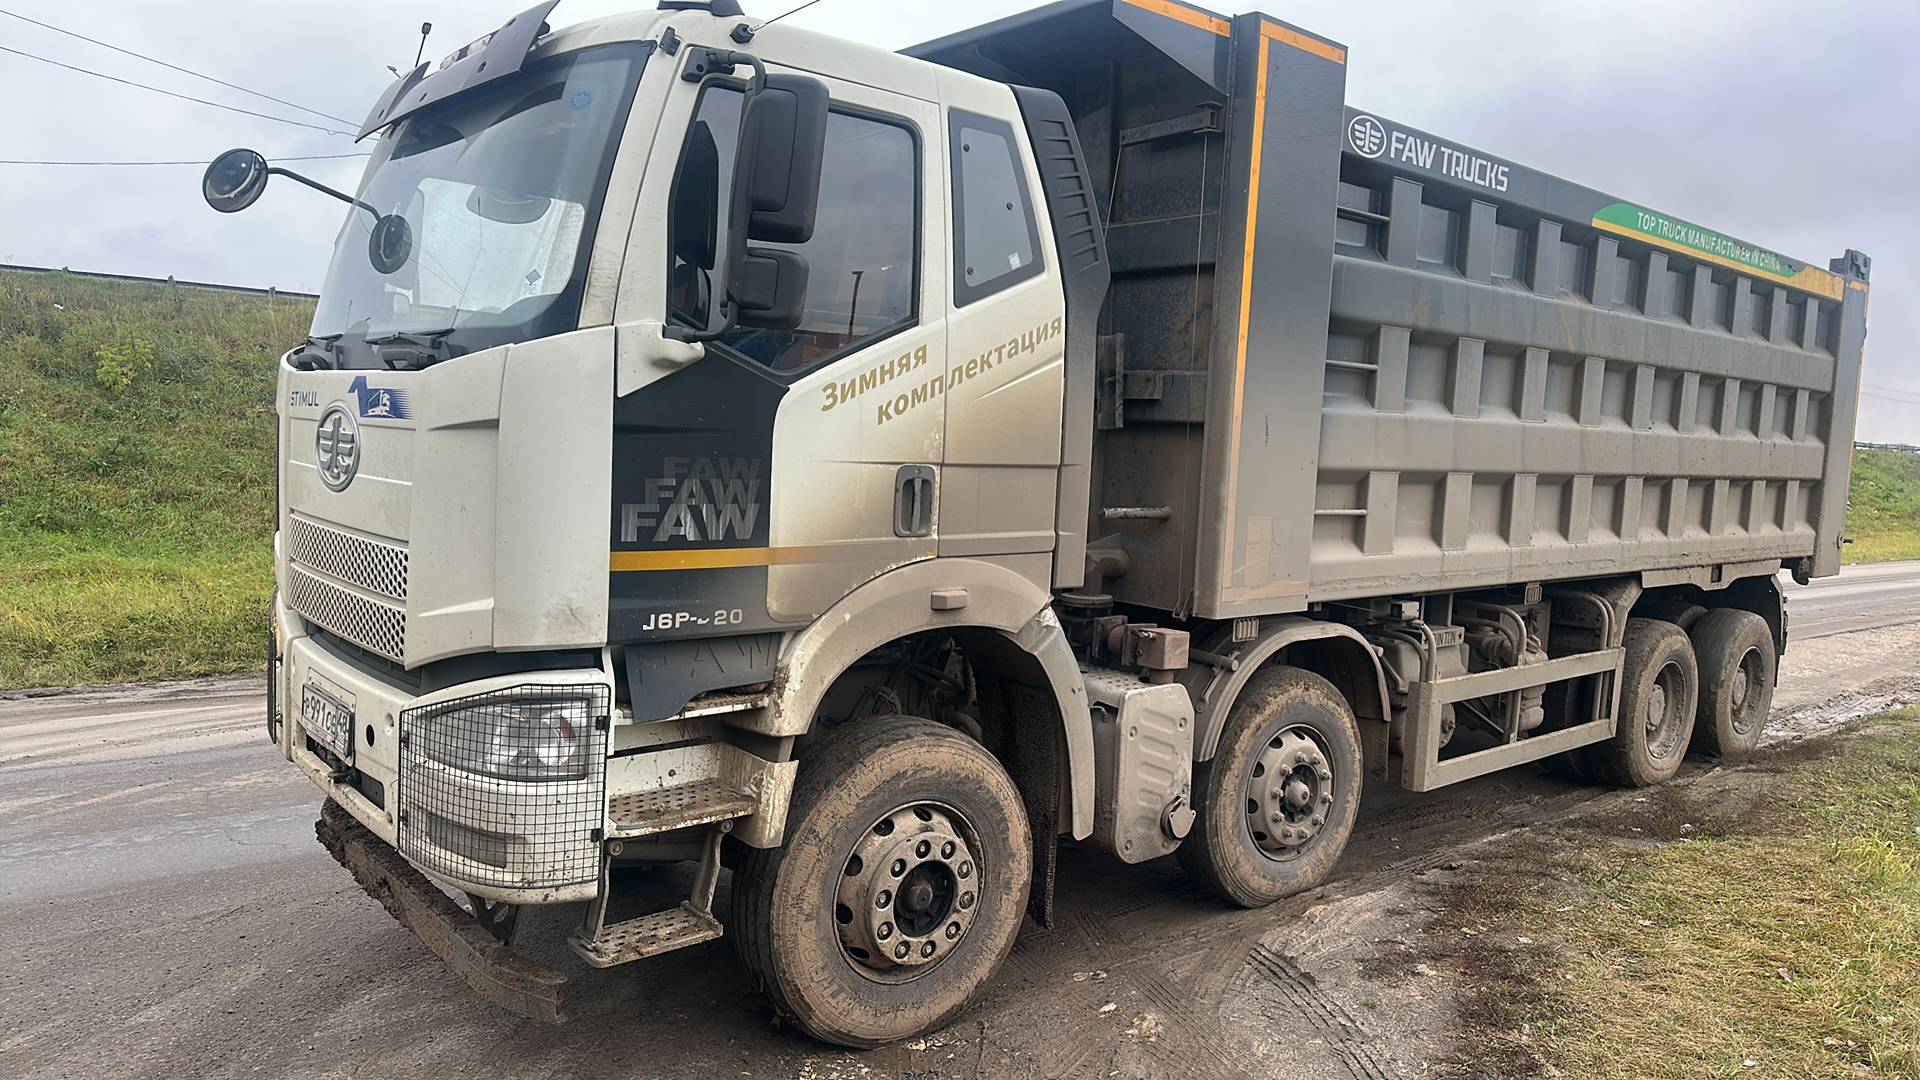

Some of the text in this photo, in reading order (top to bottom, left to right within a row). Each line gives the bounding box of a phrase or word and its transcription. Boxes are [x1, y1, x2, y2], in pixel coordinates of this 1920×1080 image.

[1390, 131, 1510, 192] FAW TRUCKS
[1637, 212, 1656, 231] TOP
[1658, 219, 1688, 243] TRUCK
[1688, 230, 1751, 261] MANUFACTURER
[821, 344, 928, 412] Зимняя
[877, 316, 1062, 425] комплектация
[290, 391, 319, 407] STIMUL
[645, 479, 761, 505] FAW
[621, 503, 761, 542] FAW
